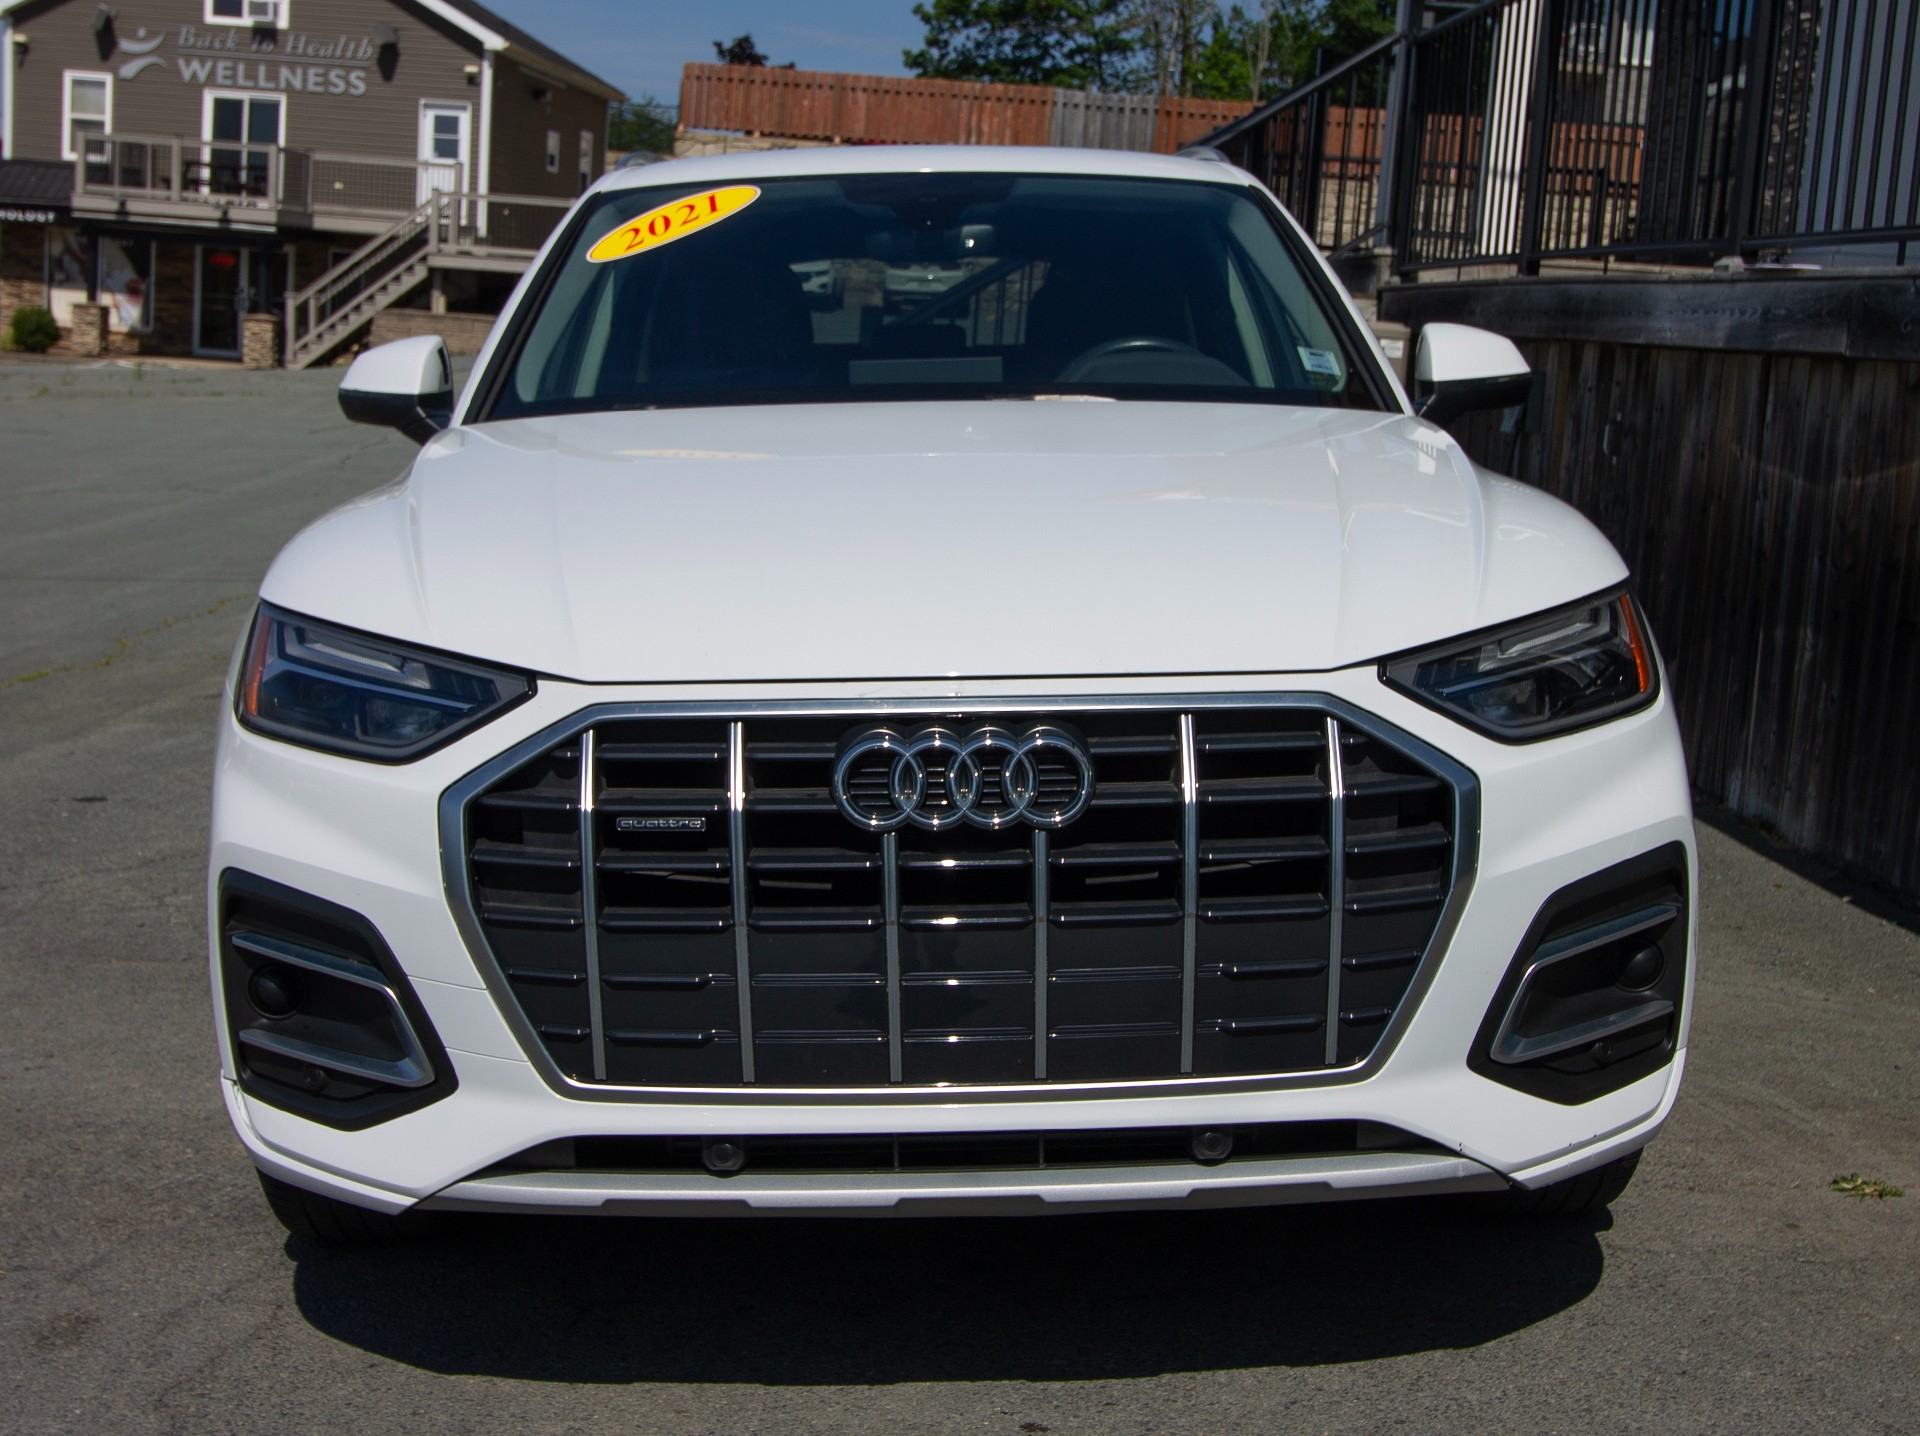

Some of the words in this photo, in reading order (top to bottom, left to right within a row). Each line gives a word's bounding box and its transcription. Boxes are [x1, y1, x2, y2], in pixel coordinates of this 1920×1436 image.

[177, 25, 240, 51] Back
[250, 34, 275, 54] to
[284, 33, 374, 61] Health
[177, 57, 368, 97] WELLNESS
[620, 194, 723, 252] 2021
[620, 819, 702, 829] quattro
